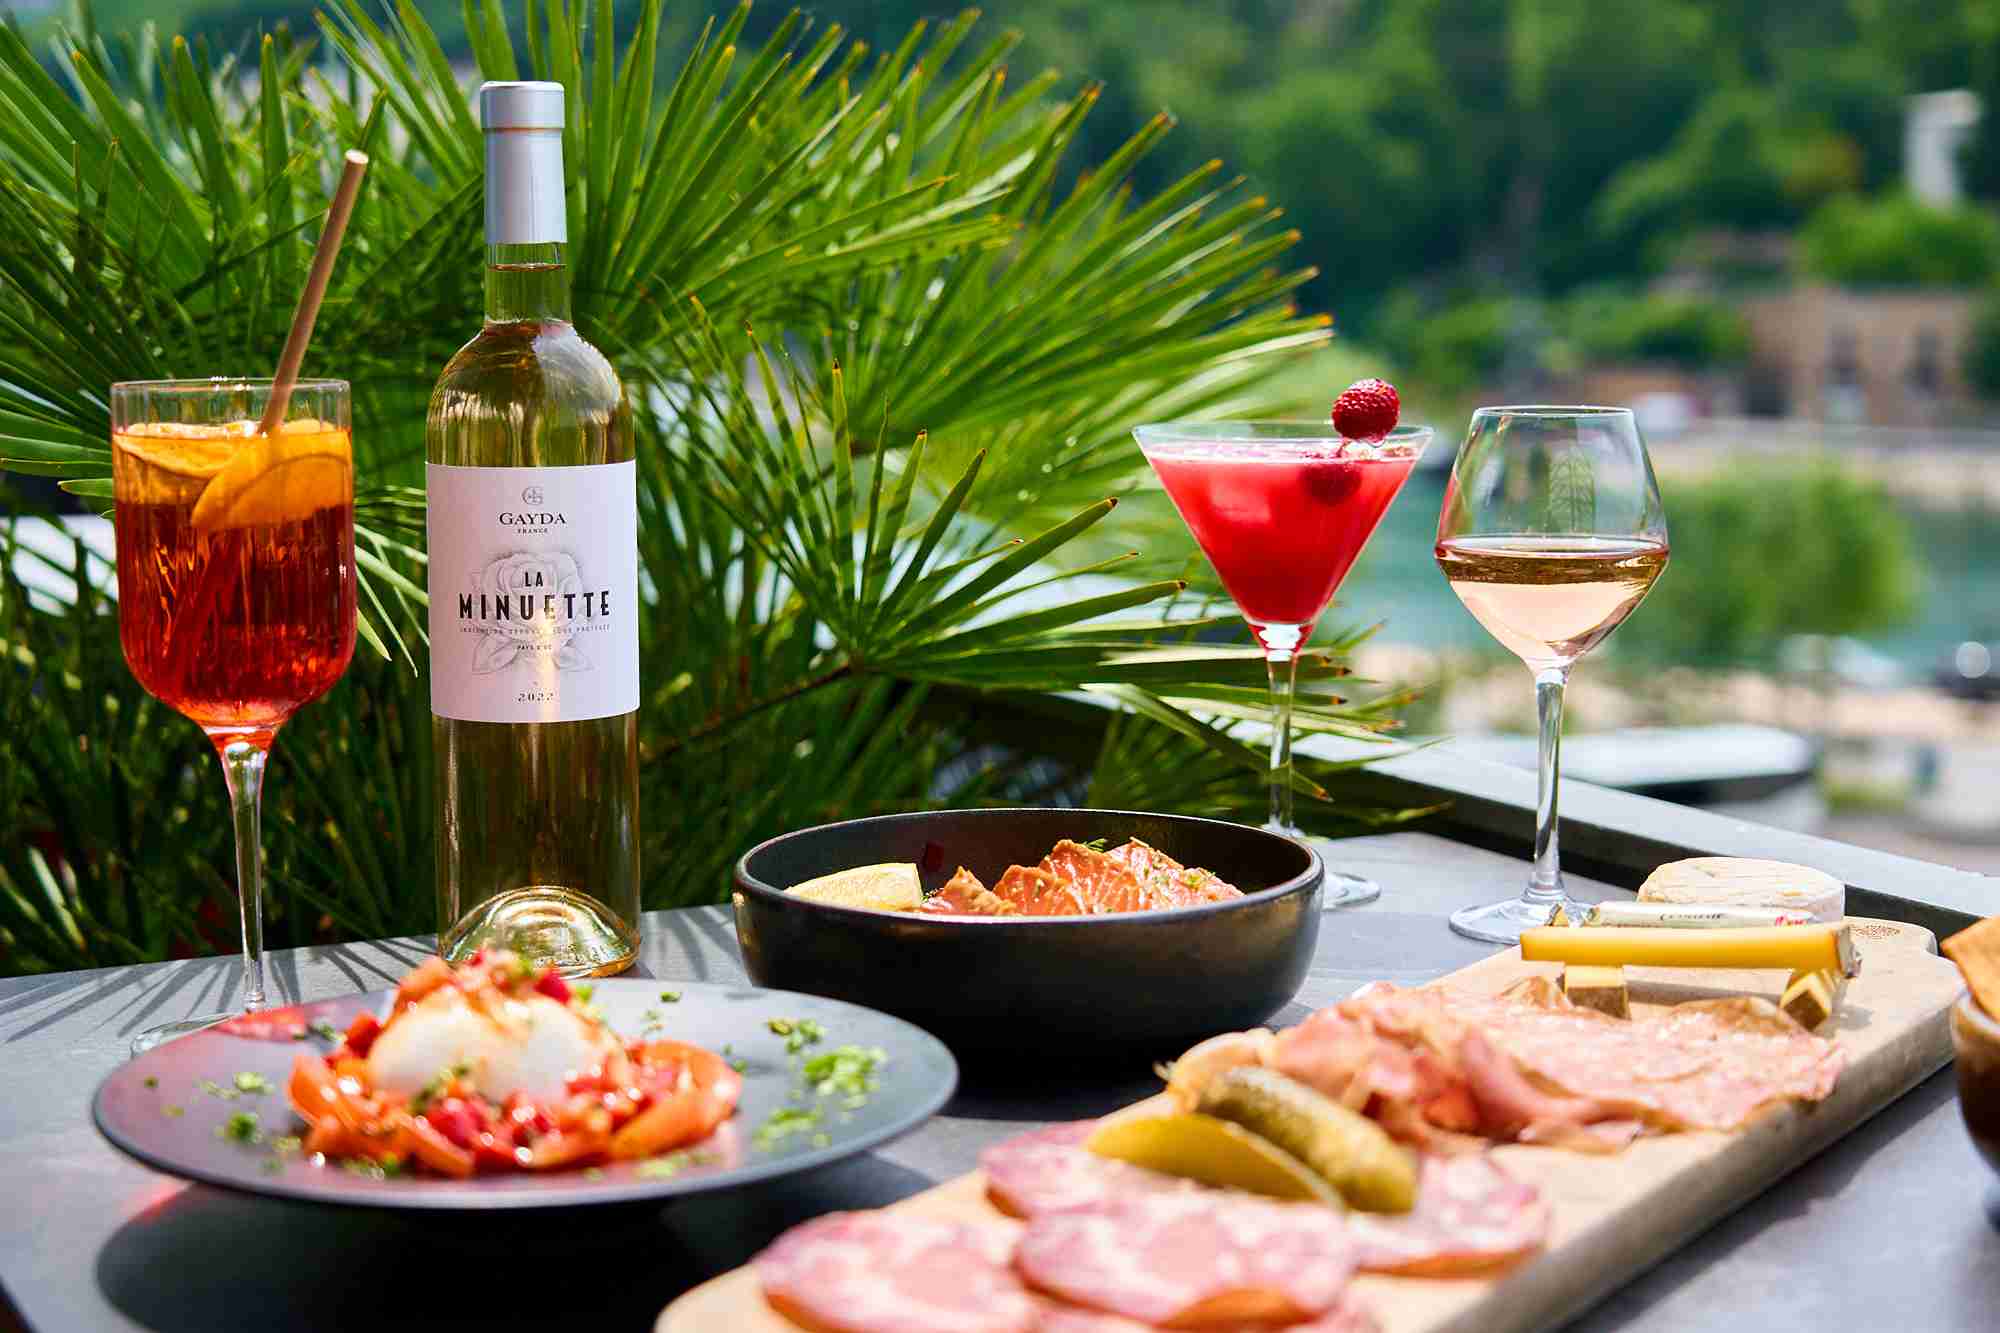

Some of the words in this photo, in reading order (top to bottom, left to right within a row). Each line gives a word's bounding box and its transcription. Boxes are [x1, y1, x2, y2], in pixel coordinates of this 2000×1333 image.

[499, 512, 567, 526] GAYDA
[524, 571, 544, 587] LA
[459, 590, 609, 620] MINUETTE
[518, 692, 554, 702] 2022
